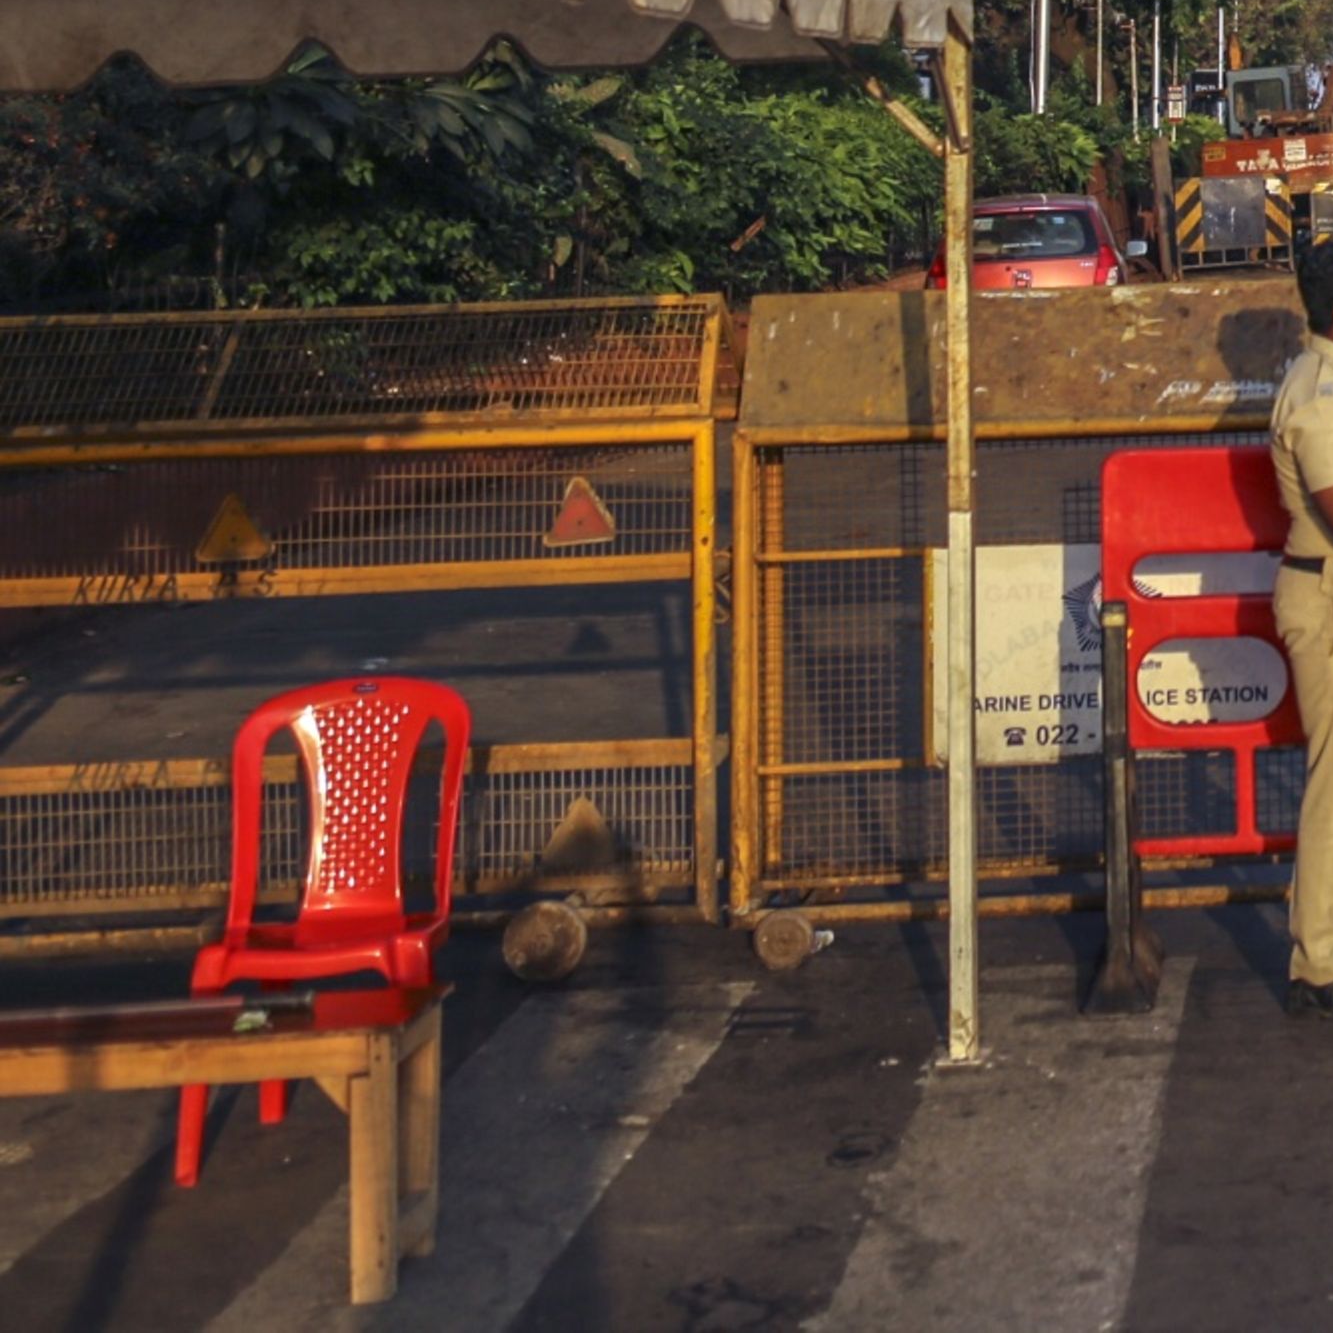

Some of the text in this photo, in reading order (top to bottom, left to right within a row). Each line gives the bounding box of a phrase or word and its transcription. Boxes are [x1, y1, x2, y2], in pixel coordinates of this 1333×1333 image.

[978, 618, 1058, 683] OLABA
[974, 685, 1269, 714] ARINE DRIVE ICE STATION
[1035, 723, 1080, 746] 022
